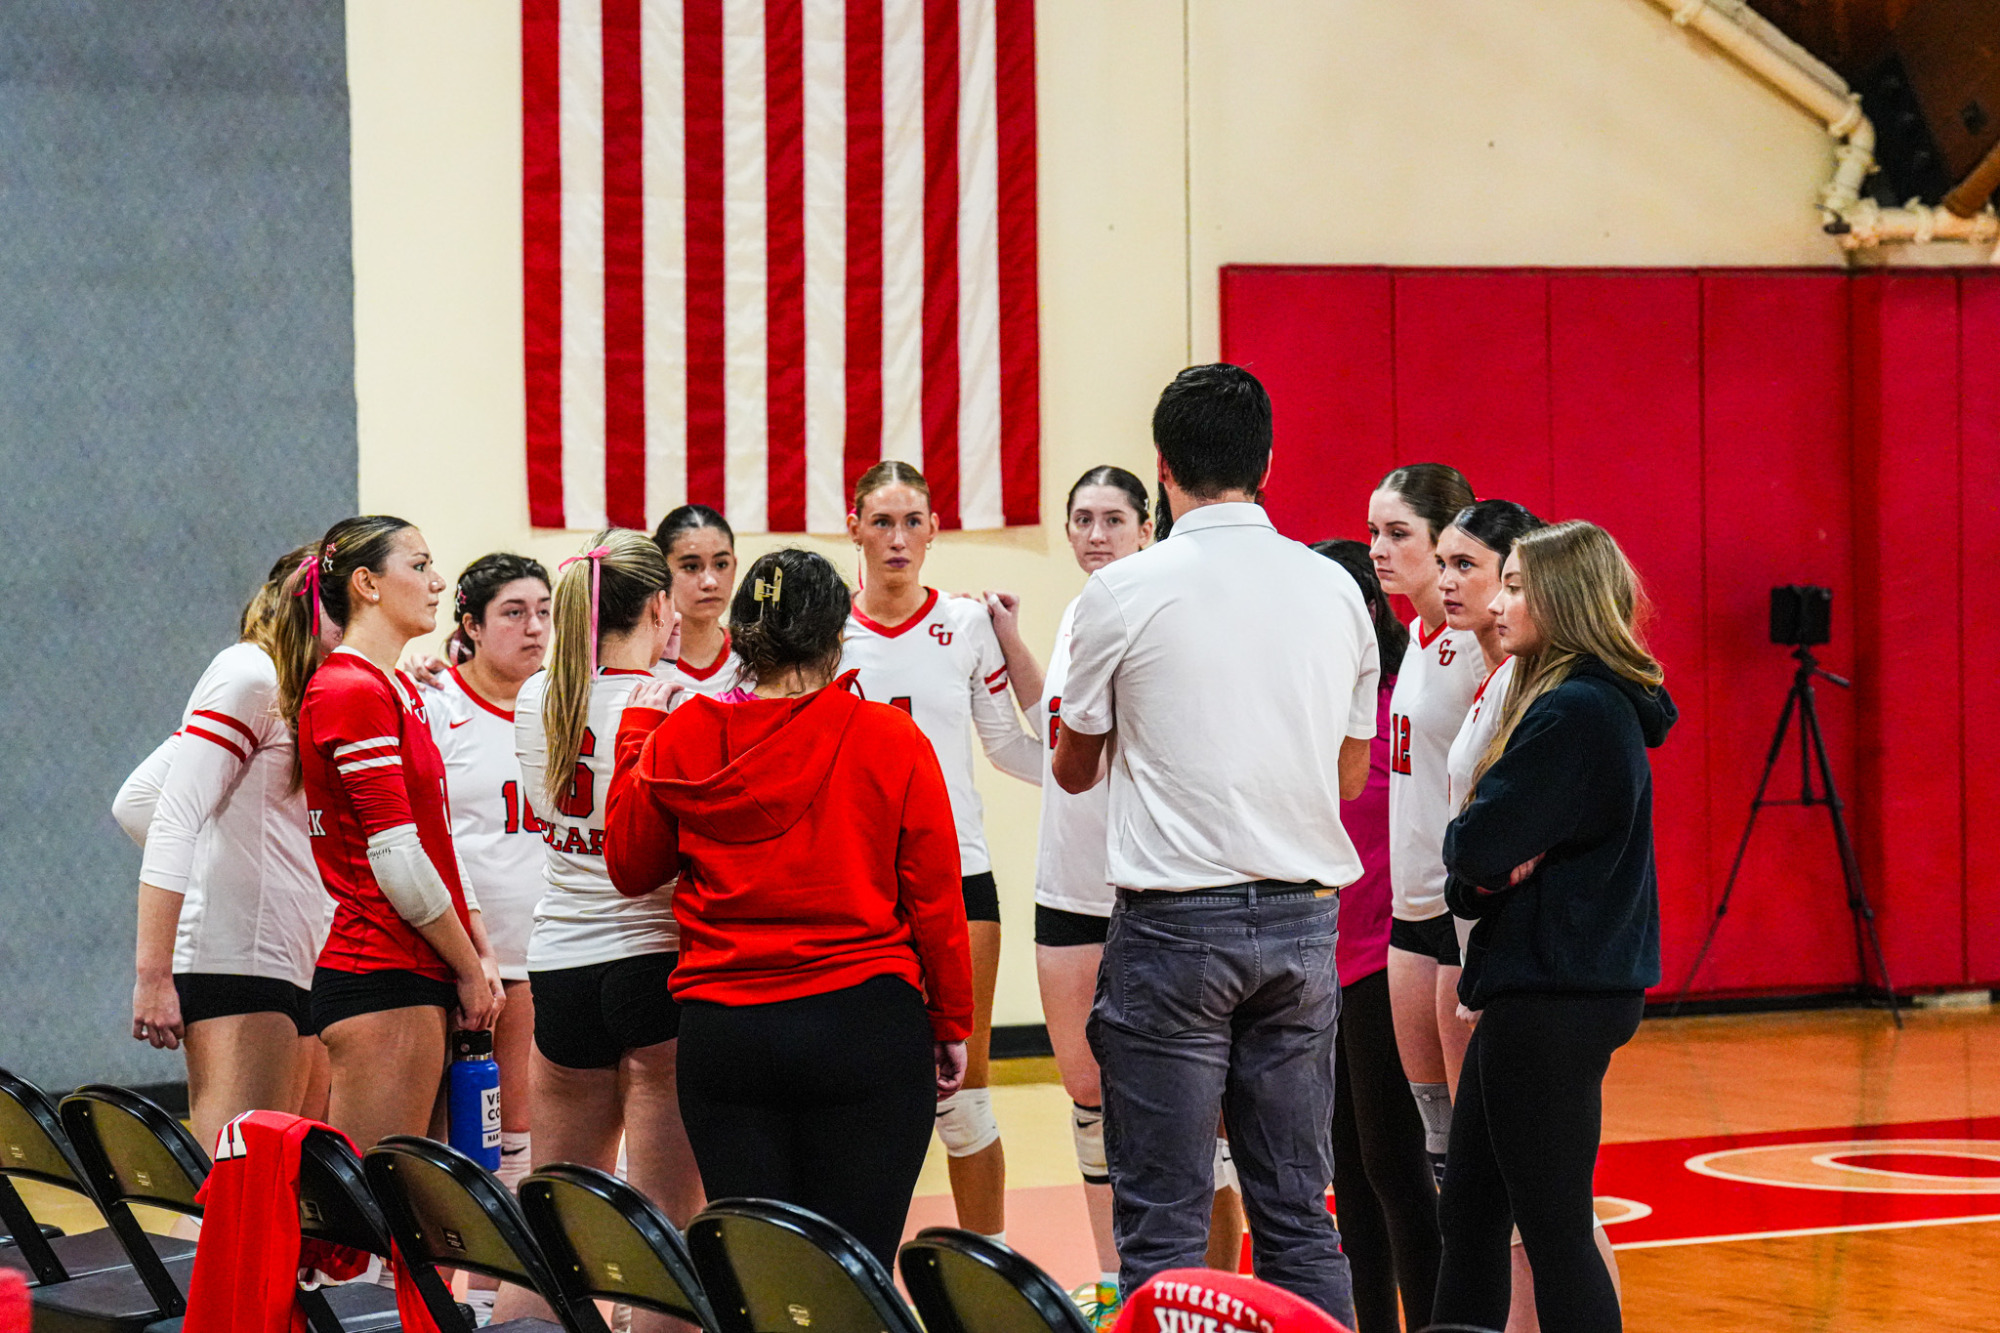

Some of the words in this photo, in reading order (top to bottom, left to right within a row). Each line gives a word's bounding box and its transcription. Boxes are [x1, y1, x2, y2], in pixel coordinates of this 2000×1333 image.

[929, 623, 953, 646] CU
[1438, 639, 1456, 666] CU
[1391, 713, 1411, 776] 12
